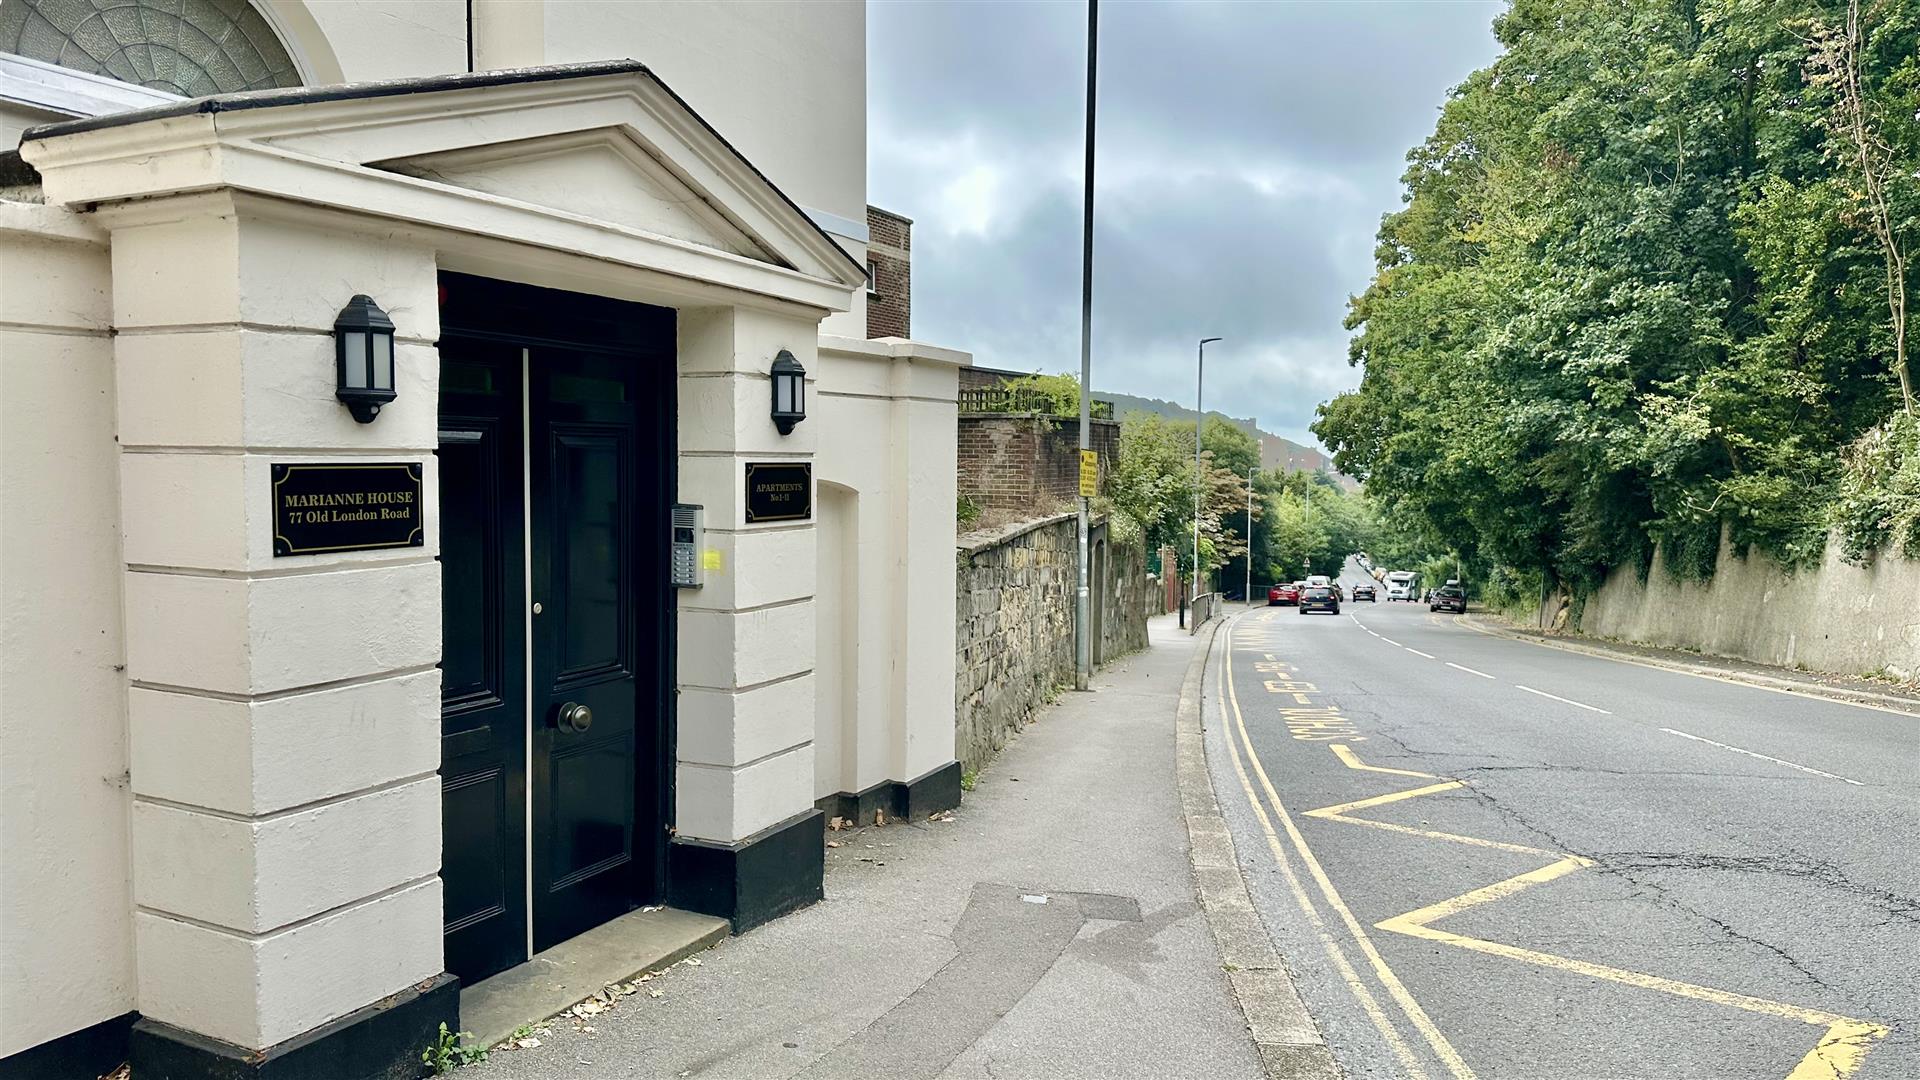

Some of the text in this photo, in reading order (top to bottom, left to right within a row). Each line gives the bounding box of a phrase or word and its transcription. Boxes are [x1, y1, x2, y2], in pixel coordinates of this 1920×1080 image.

[756, 483, 803, 493] APARTMENTS
[285, 491, 413, 507] MARIANNE HOUSE
[289, 507, 410, 524] 77 Old London Road
[1278, 705, 1368, 741] SCHOOL
